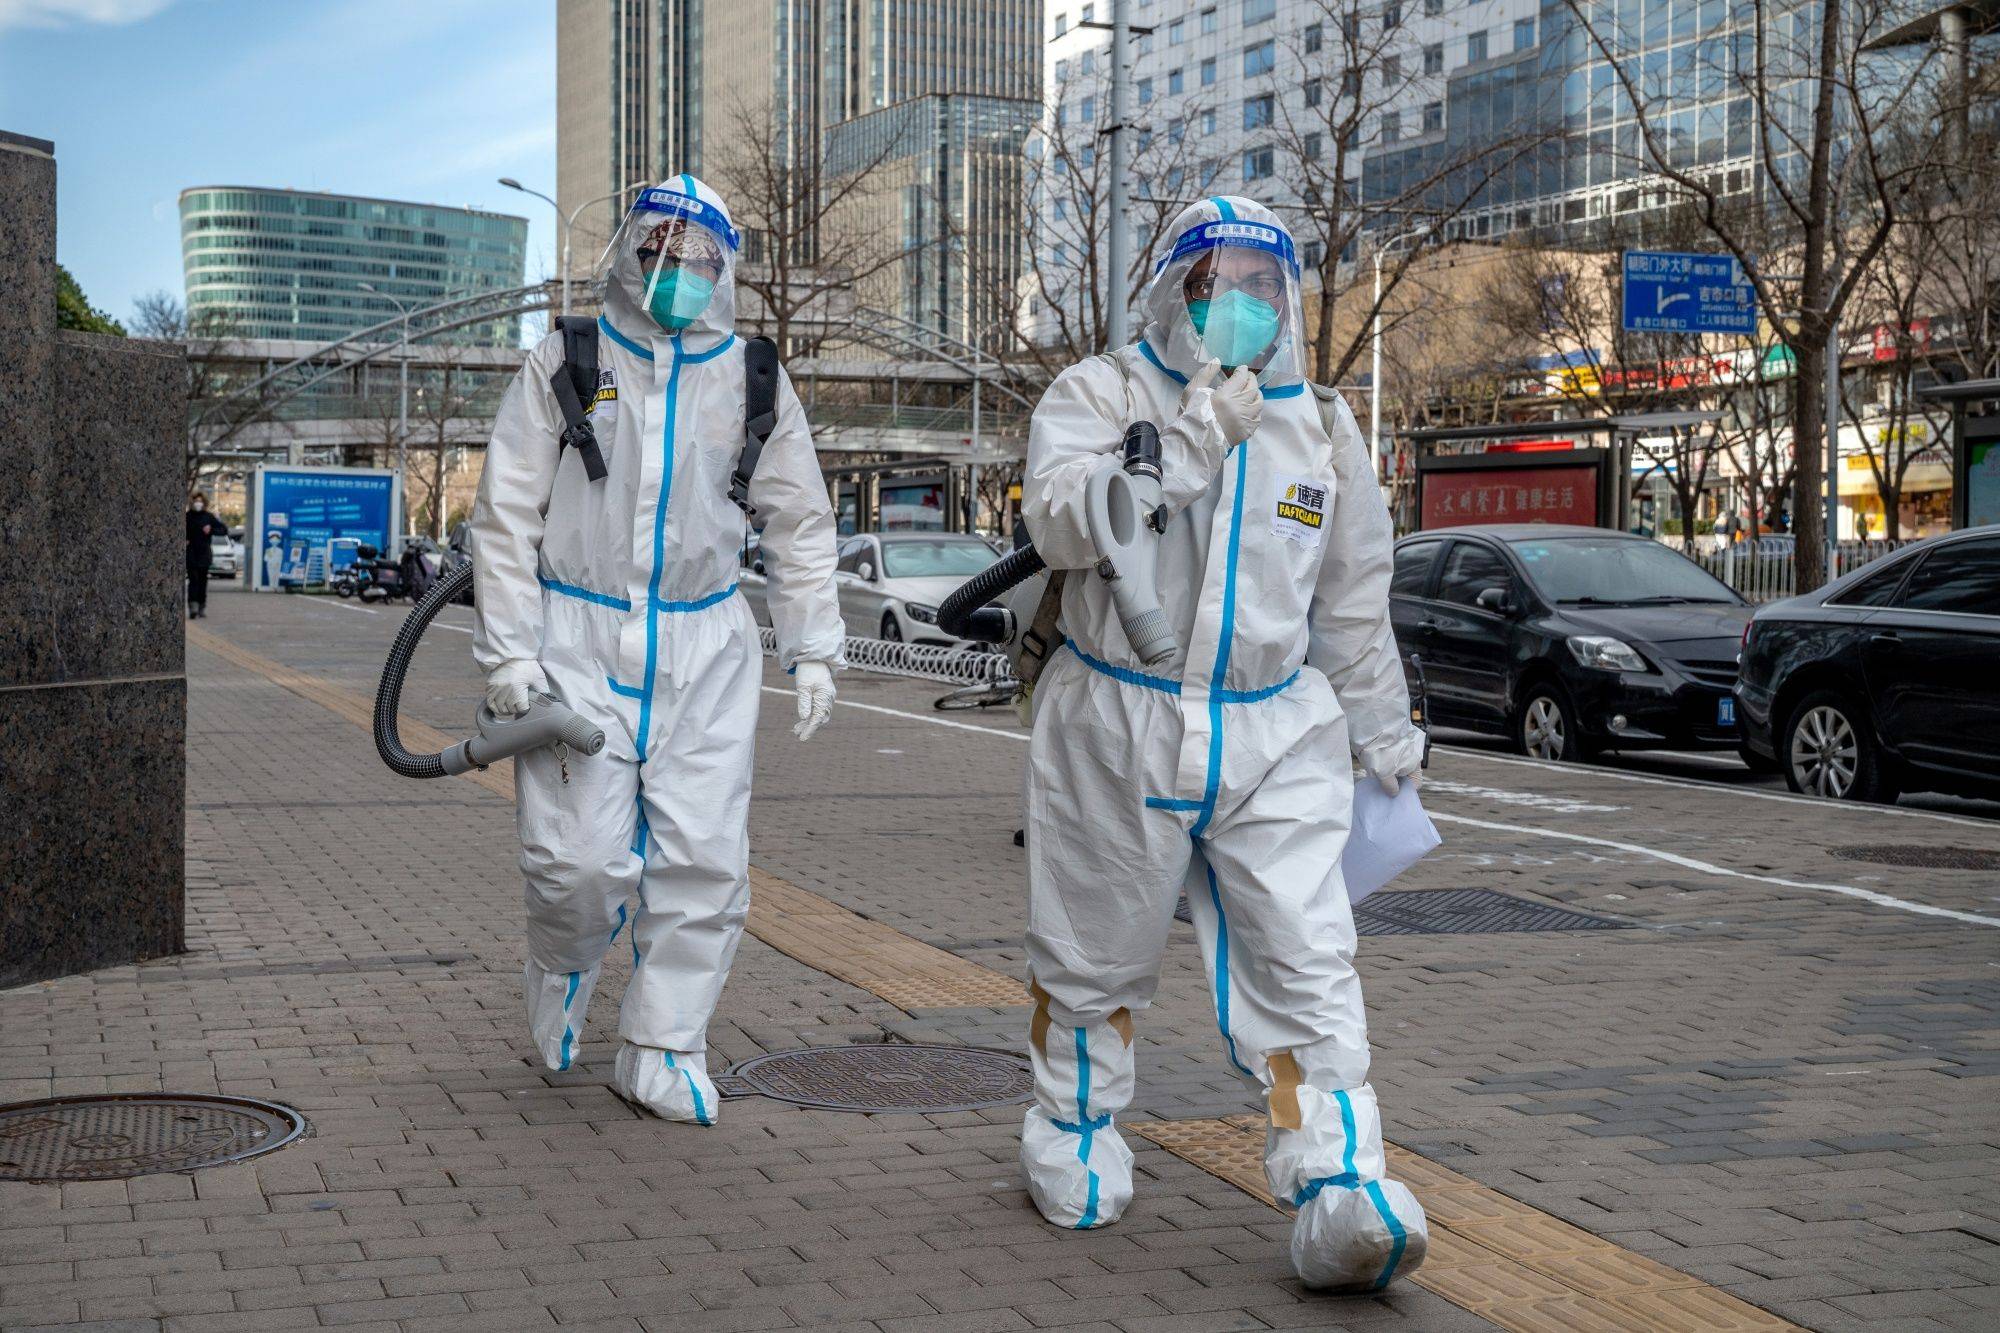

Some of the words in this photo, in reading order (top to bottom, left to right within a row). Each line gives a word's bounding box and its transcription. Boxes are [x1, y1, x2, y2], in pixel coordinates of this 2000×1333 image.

[1628, 255, 1692, 273] 朝阳门外大街
[1700, 286, 1748, 303] 吉市口路
[599, 370, 614, 387] 清
[1515, 487, 1574, 511] 健康生活
